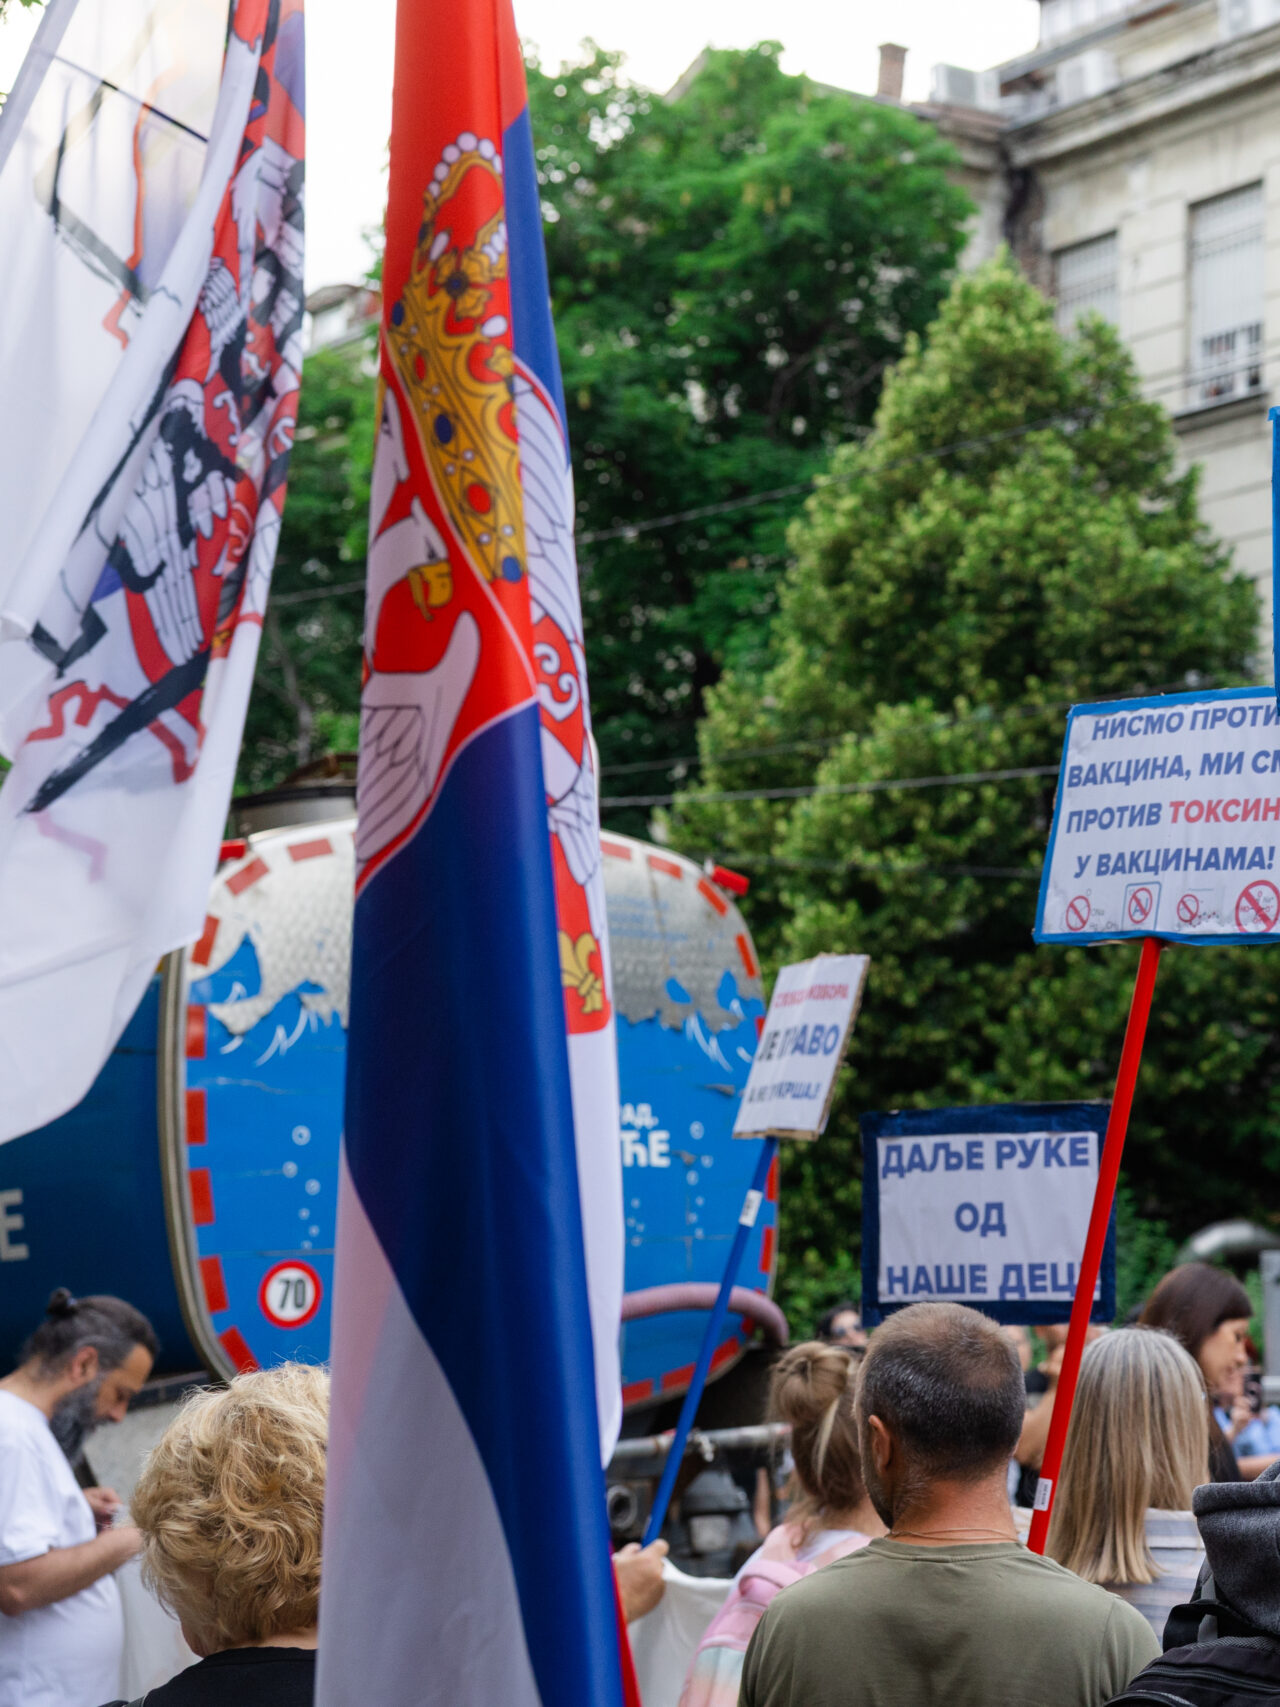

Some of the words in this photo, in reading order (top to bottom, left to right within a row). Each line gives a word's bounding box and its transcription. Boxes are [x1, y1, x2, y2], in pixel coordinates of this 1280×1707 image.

[1091, 711, 1184, 741] НИСМО
[1067, 755, 1191, 788] ВАКЦИНА,
[1199, 751, 1245, 776] МИ
[1066, 802, 1162, 834] ПРОТИВ
[1073, 855, 1091, 879] У
[1096, 846, 1276, 877] ВАКЦИНАМА!
[779, 1023, 840, 1059] ПАВО
[618, 1129, 671, 1168] ЋЕ
[882, 1140, 985, 1179] ДАЉЕ
[995, 1136, 1090, 1170] РУКЕ
[954, 1201, 1007, 1237] ОД
[279, 1278, 306, 1310] 70
[886, 1264, 988, 1296] НАШЕ
[998, 1262, 1100, 1300] ДЕЦ
